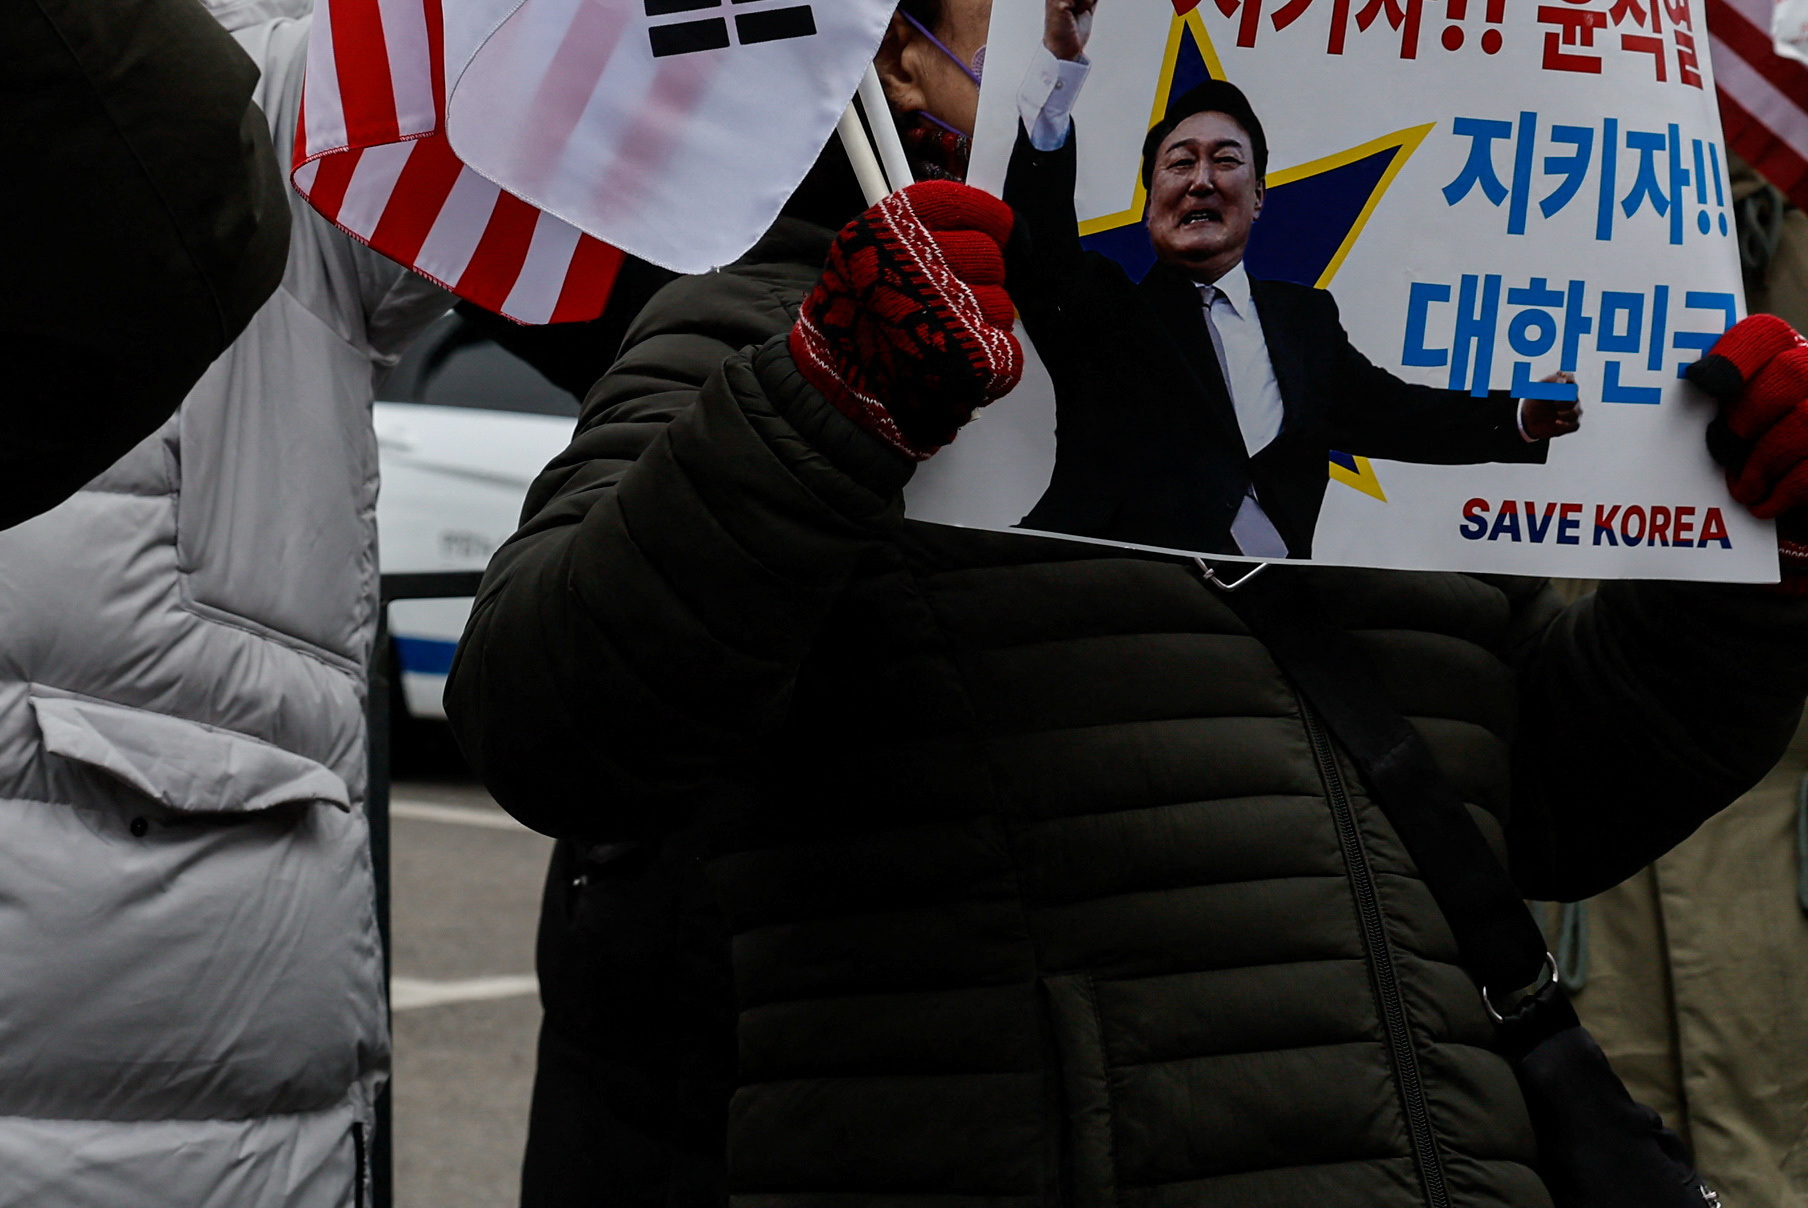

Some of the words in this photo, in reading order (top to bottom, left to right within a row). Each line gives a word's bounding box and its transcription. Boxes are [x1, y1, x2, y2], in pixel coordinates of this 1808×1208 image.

[1441, 110, 1728, 245] 지키자!!
[1459, 497, 1583, 545] SAVE
[1592, 504, 1733, 550] KOREA
